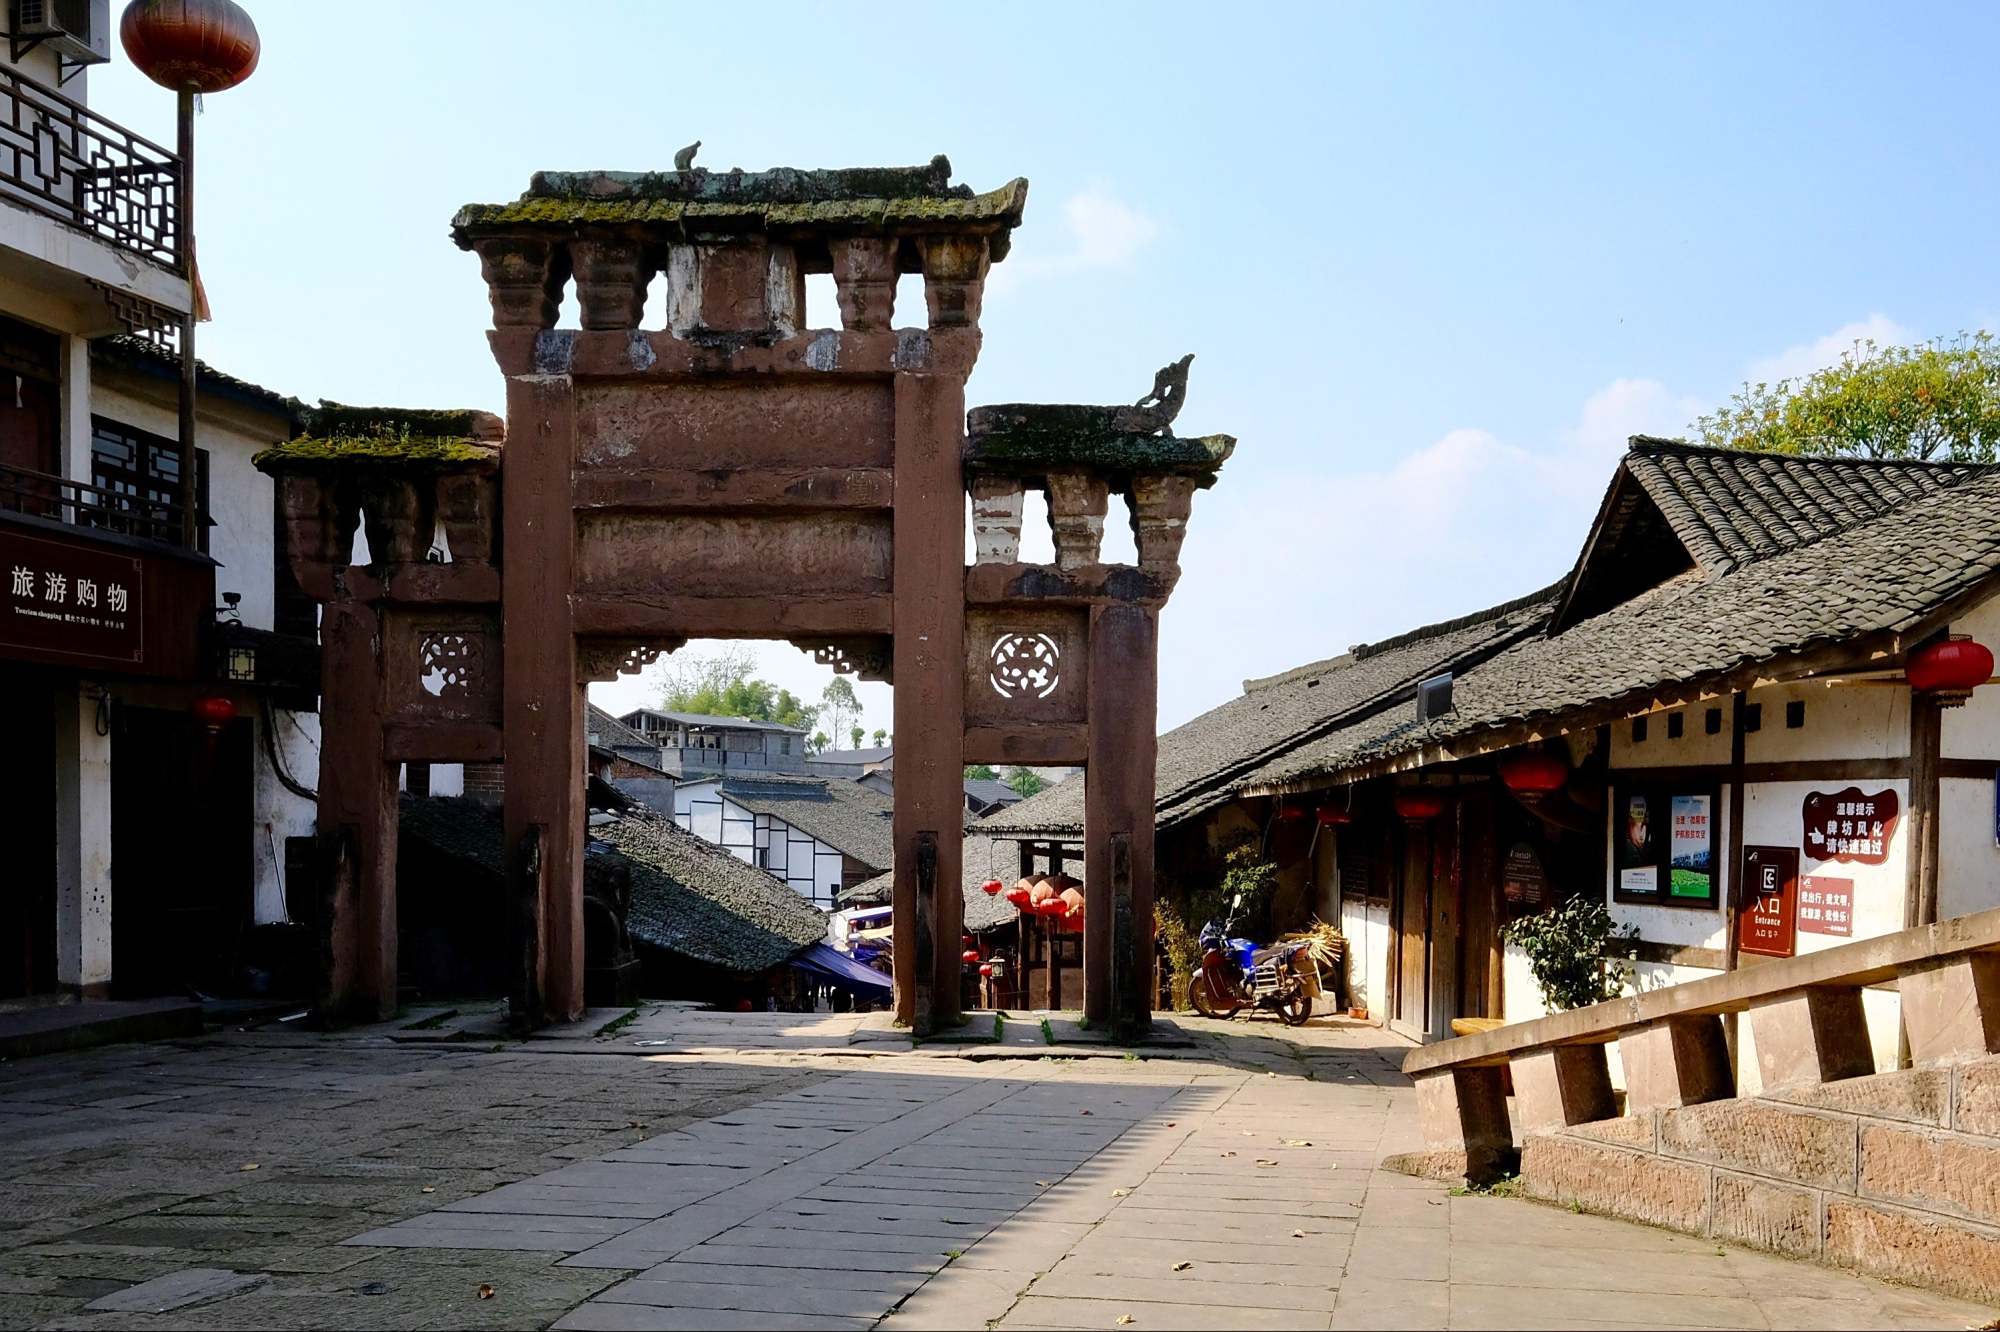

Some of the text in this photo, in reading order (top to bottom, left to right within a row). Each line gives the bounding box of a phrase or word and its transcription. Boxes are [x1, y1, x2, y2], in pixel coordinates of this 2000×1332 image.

[12, 565, 127, 612] 旅游购物
[14, 606, 62, 621] Tourism shopping
[1837, 803, 1875, 816] 温馨提示
[1826, 820, 1883, 837] 牌坊风化
[1826, 838, 1883, 855] 请快速通过
[1753, 896, 1780, 914] 入口
[1755, 915, 1781, 926] Entrance
